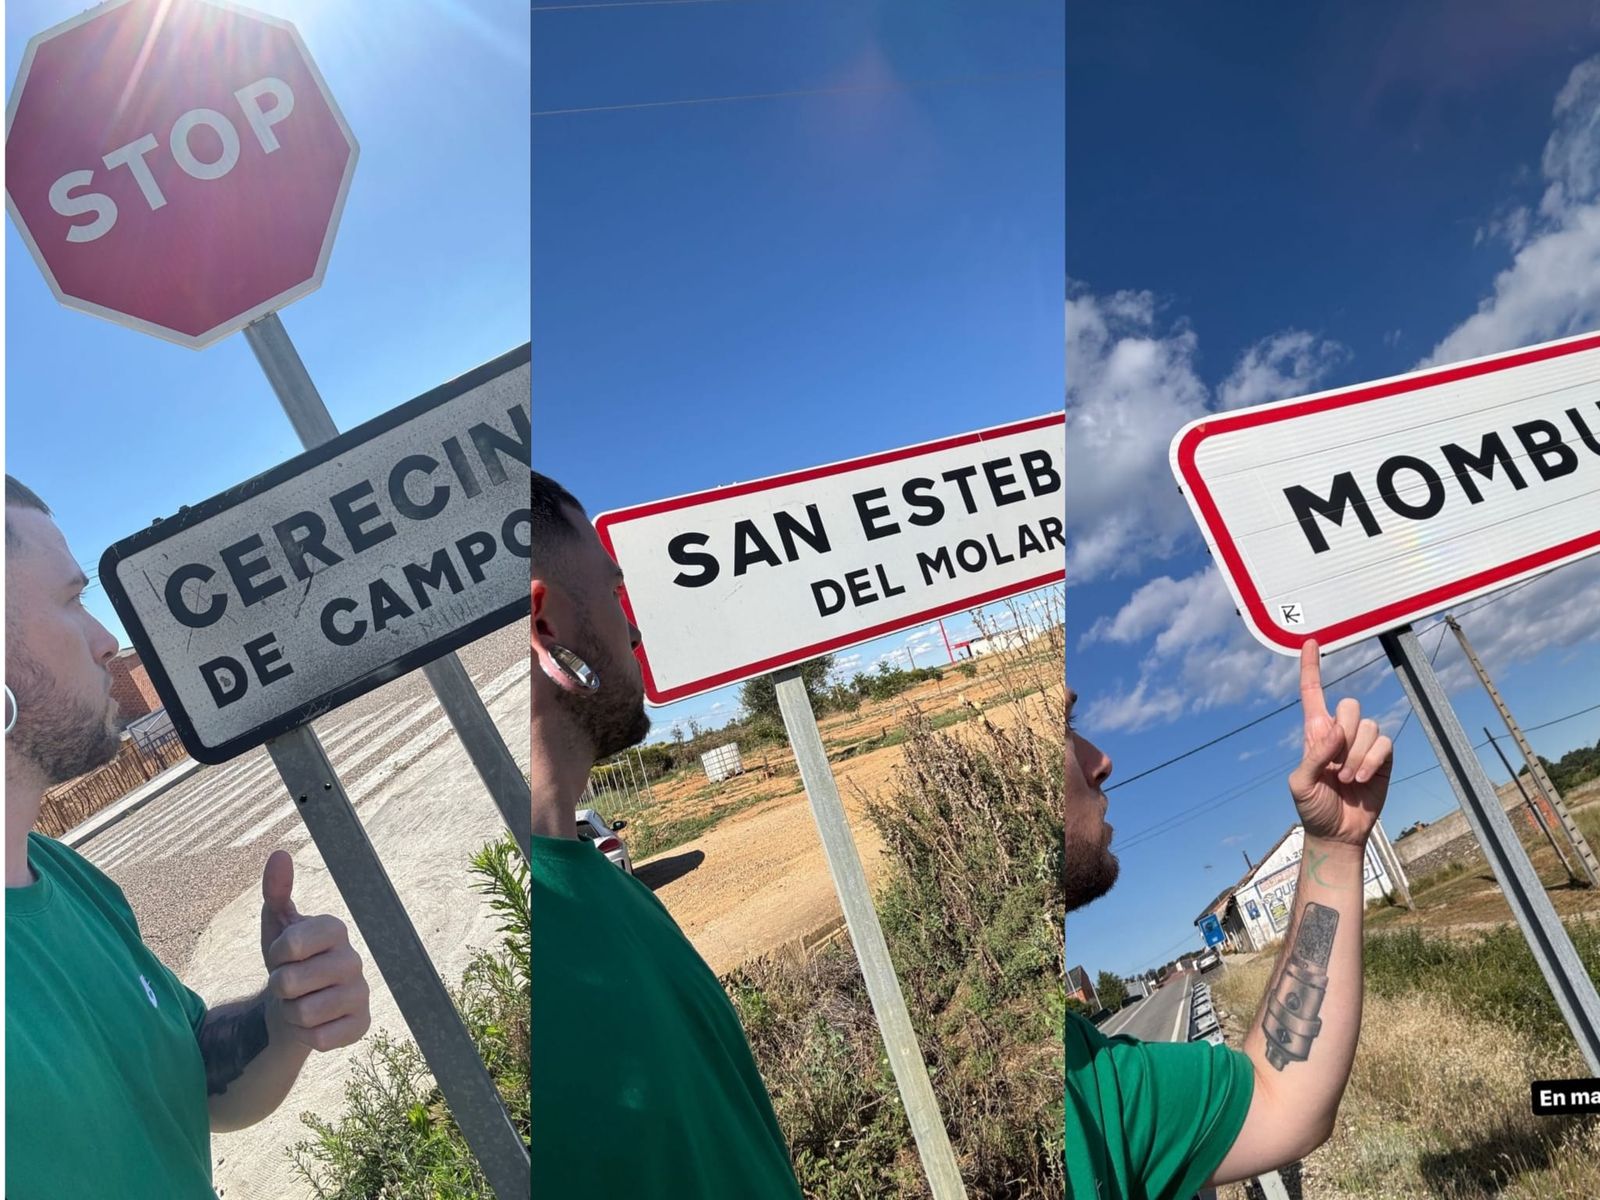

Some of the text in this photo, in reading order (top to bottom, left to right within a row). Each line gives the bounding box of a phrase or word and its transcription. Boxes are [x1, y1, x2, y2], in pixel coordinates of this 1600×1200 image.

[47, 76, 296, 244] STOP
[162, 403, 531, 630] CERECIN
[667, 449, 1062, 588] SAN ESTEB
[810, 516, 1065, 618] DEL MOLAR
[199, 508, 531, 709] DE CAMPO
